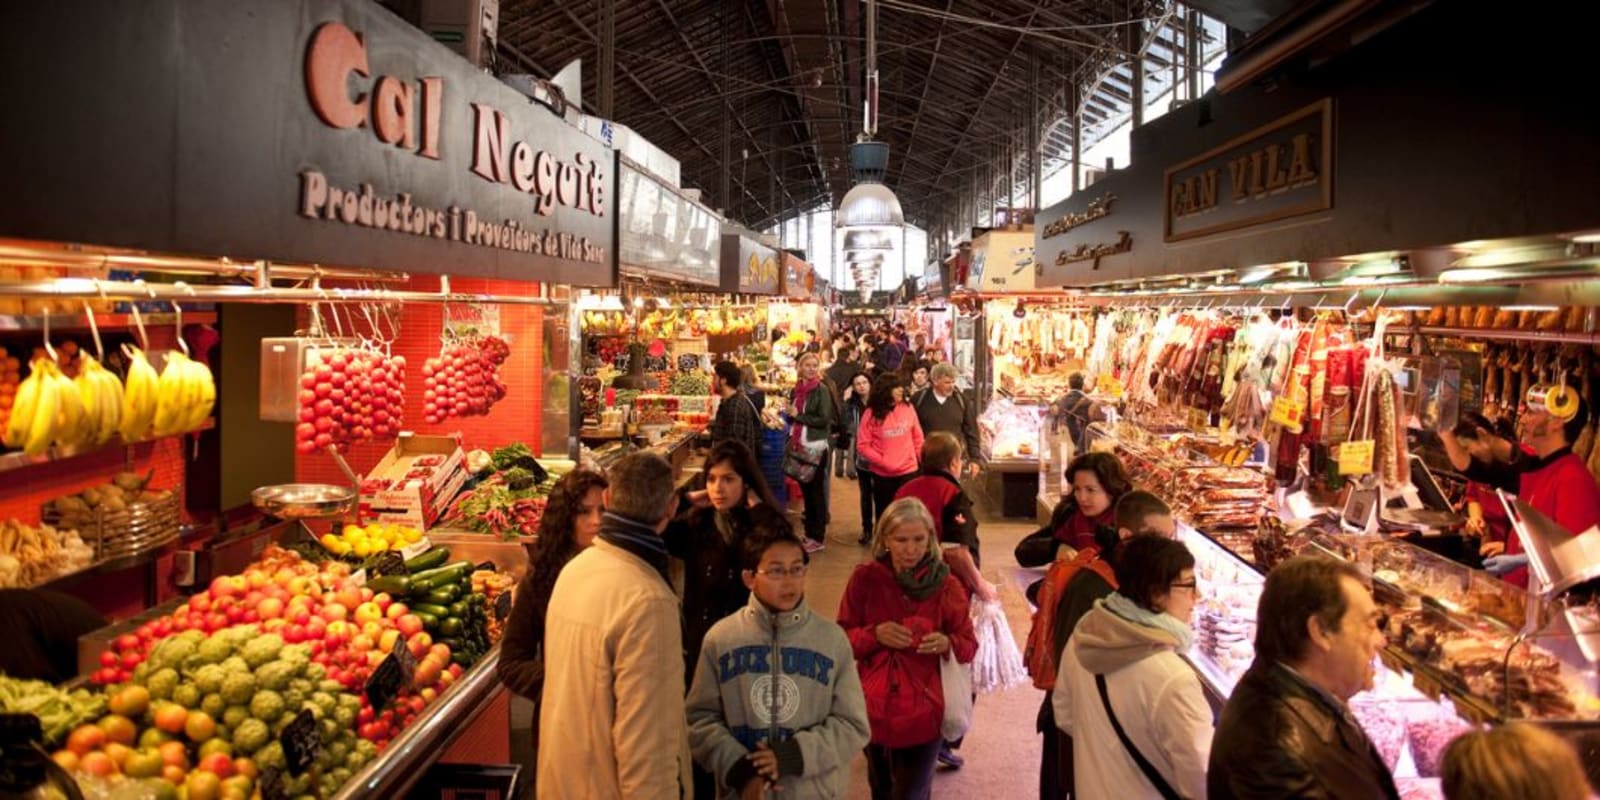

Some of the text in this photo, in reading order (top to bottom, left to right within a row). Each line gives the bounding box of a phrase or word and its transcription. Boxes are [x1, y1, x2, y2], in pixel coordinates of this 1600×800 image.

[304, 21, 605, 217] Cal Neguit
[299, 170, 446, 239] Productors
[451, 206, 460, 240] i
[465, 210, 543, 254] Proveïdors
[543, 228, 558, 257] de
[1171, 168, 1219, 218] CAN
[1228, 134, 1318, 204] VILA
